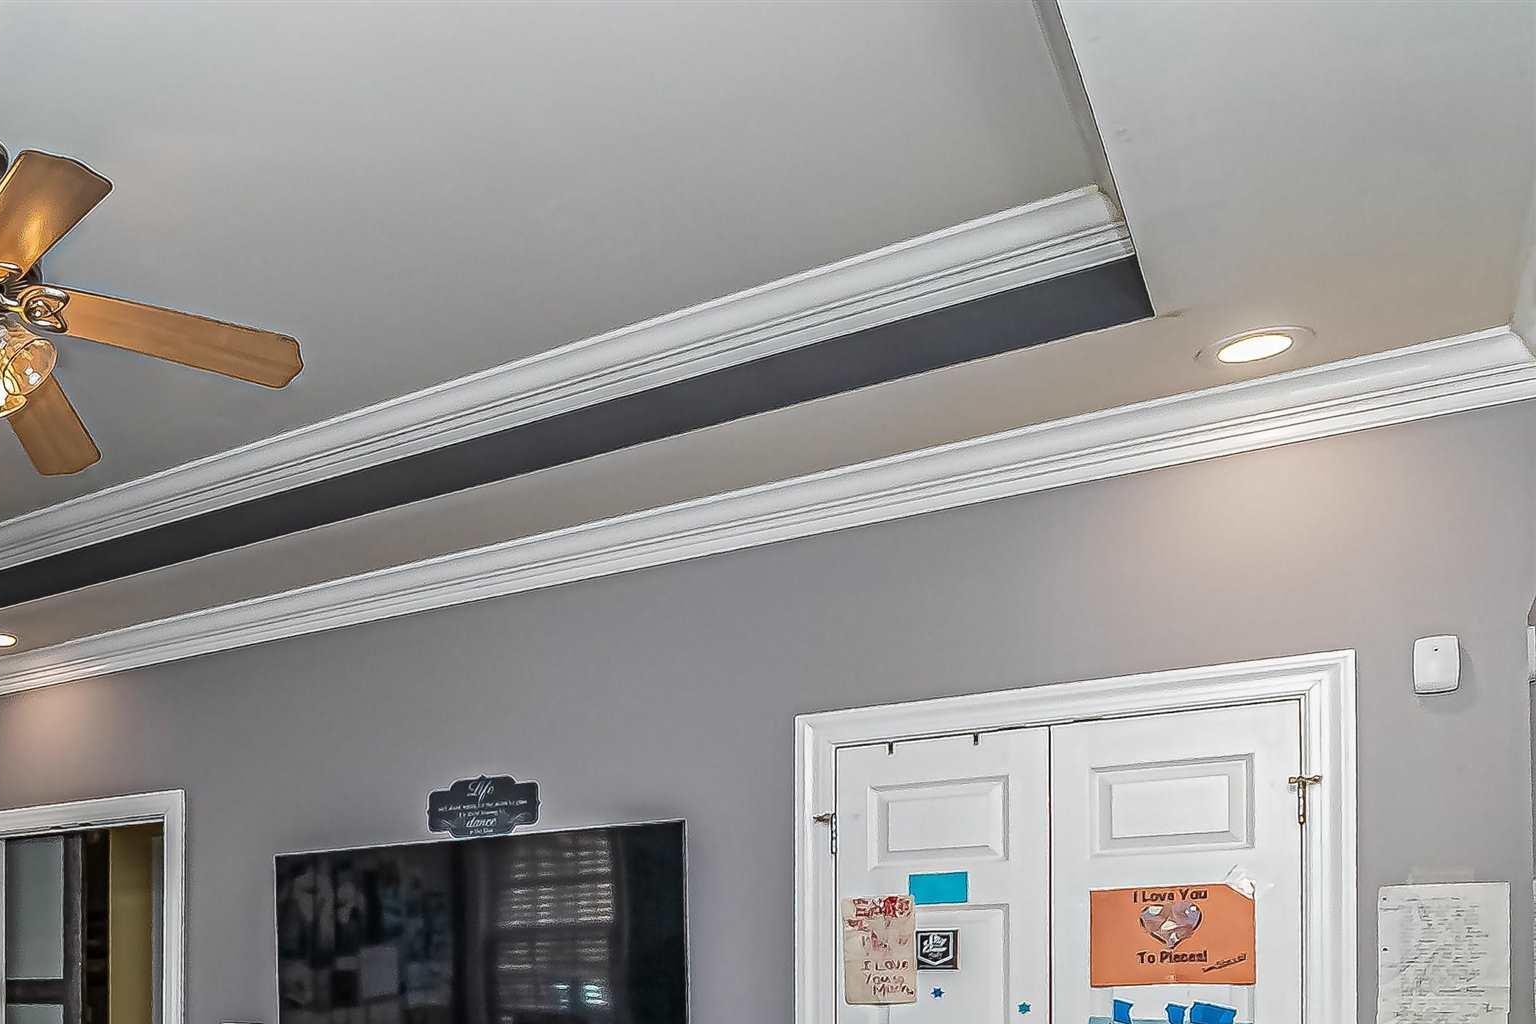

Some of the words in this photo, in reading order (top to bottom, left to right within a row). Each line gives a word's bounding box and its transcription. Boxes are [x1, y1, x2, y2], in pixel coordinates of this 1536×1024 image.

[1133, 893, 1138, 903] I
[1142, 891, 1175, 903] Love
[1179, 889, 1208, 901] You
[1137, 951, 1155, 965] To
[1160, 949, 1208, 965] Pieces!
